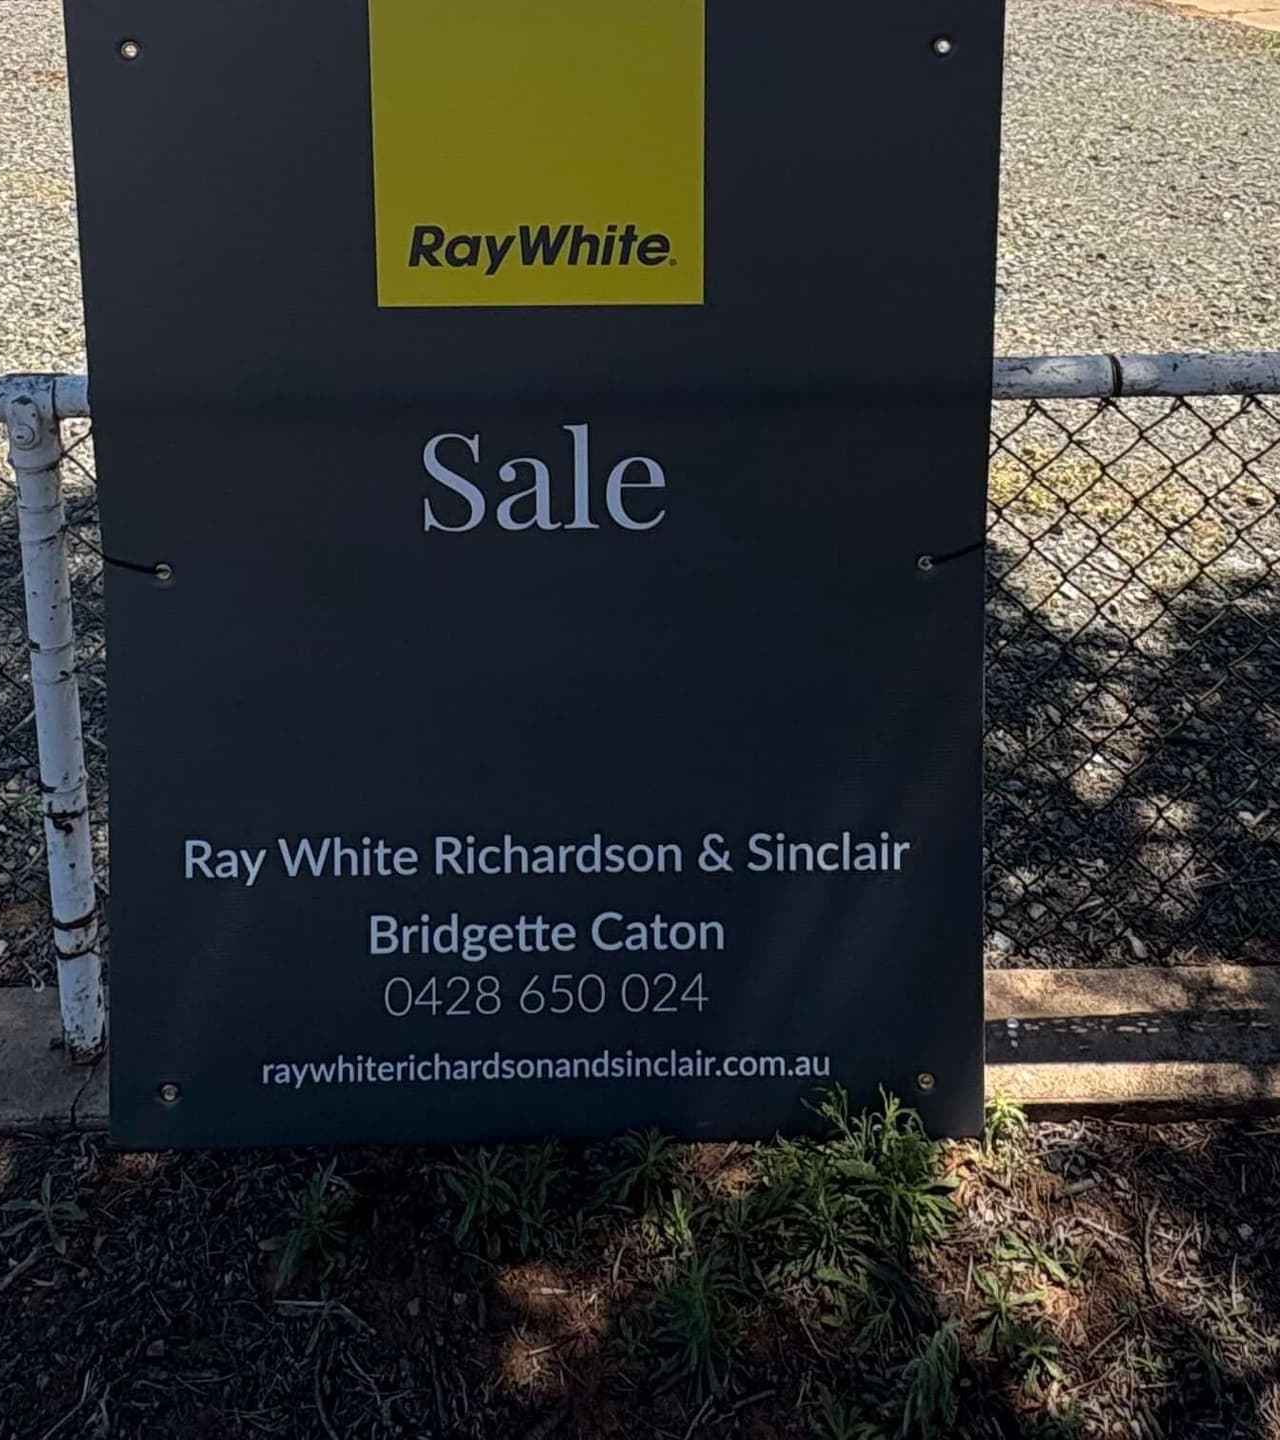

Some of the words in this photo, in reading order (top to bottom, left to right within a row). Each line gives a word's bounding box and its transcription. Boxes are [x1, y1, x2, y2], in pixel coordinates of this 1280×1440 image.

[422, 423, 667, 532] Sale
[185, 839, 267, 887] Ray
[277, 836, 418, 878] White
[435, 833, 683, 876] Richardson
[698, 833, 733, 873] &
[747, 831, 911, 873] Sinclair
[370, 913, 577, 962] Bridgette
[591, 911, 725, 952] Caton
[384, 975, 502, 1017] 0428
[519, 973, 606, 1014] 650
[621, 972, 709, 1013] 024
[262, 1049, 832, 1089] raywhiterichardsonandsinclair.com.au
